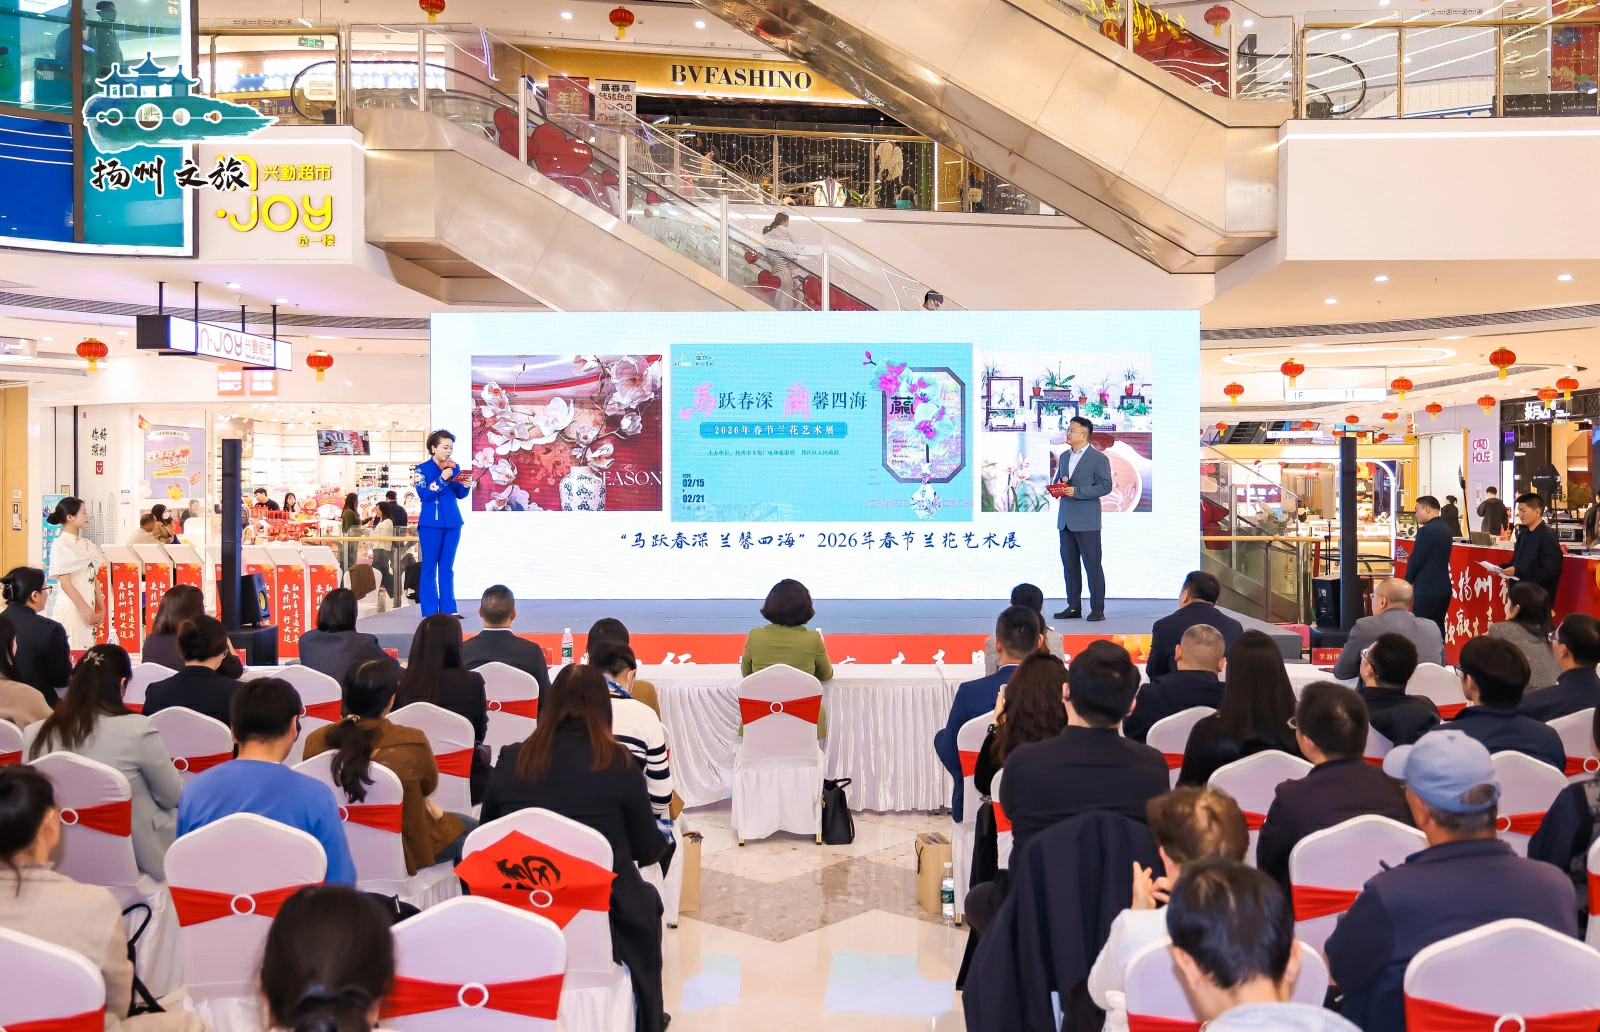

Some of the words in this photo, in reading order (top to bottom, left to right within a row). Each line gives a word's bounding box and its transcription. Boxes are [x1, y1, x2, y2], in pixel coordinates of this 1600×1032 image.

[671, 64, 812, 91] BVFASHINO
[601, 83, 631, 93] 盛香亭
[557, 91, 584, 105] 年在
[264, 106, 294, 115] 포장마차
[263, 164, 333, 182] 兴勤超市
[297, 234, 336, 247] 负一楼
[91, 427, 107, 441] 你好
[713, 424, 836, 436] 2026年春节兰花艺术展
[91, 443, 107, 457] 深圳
[1472, 438, 1489, 451] CARD
[1472, 451, 1491, 464] HOUSE
[593, 470, 662, 486] SEASON
[682, 479, 705, 487] 02/15
[682, 494, 705, 503] 02/21
